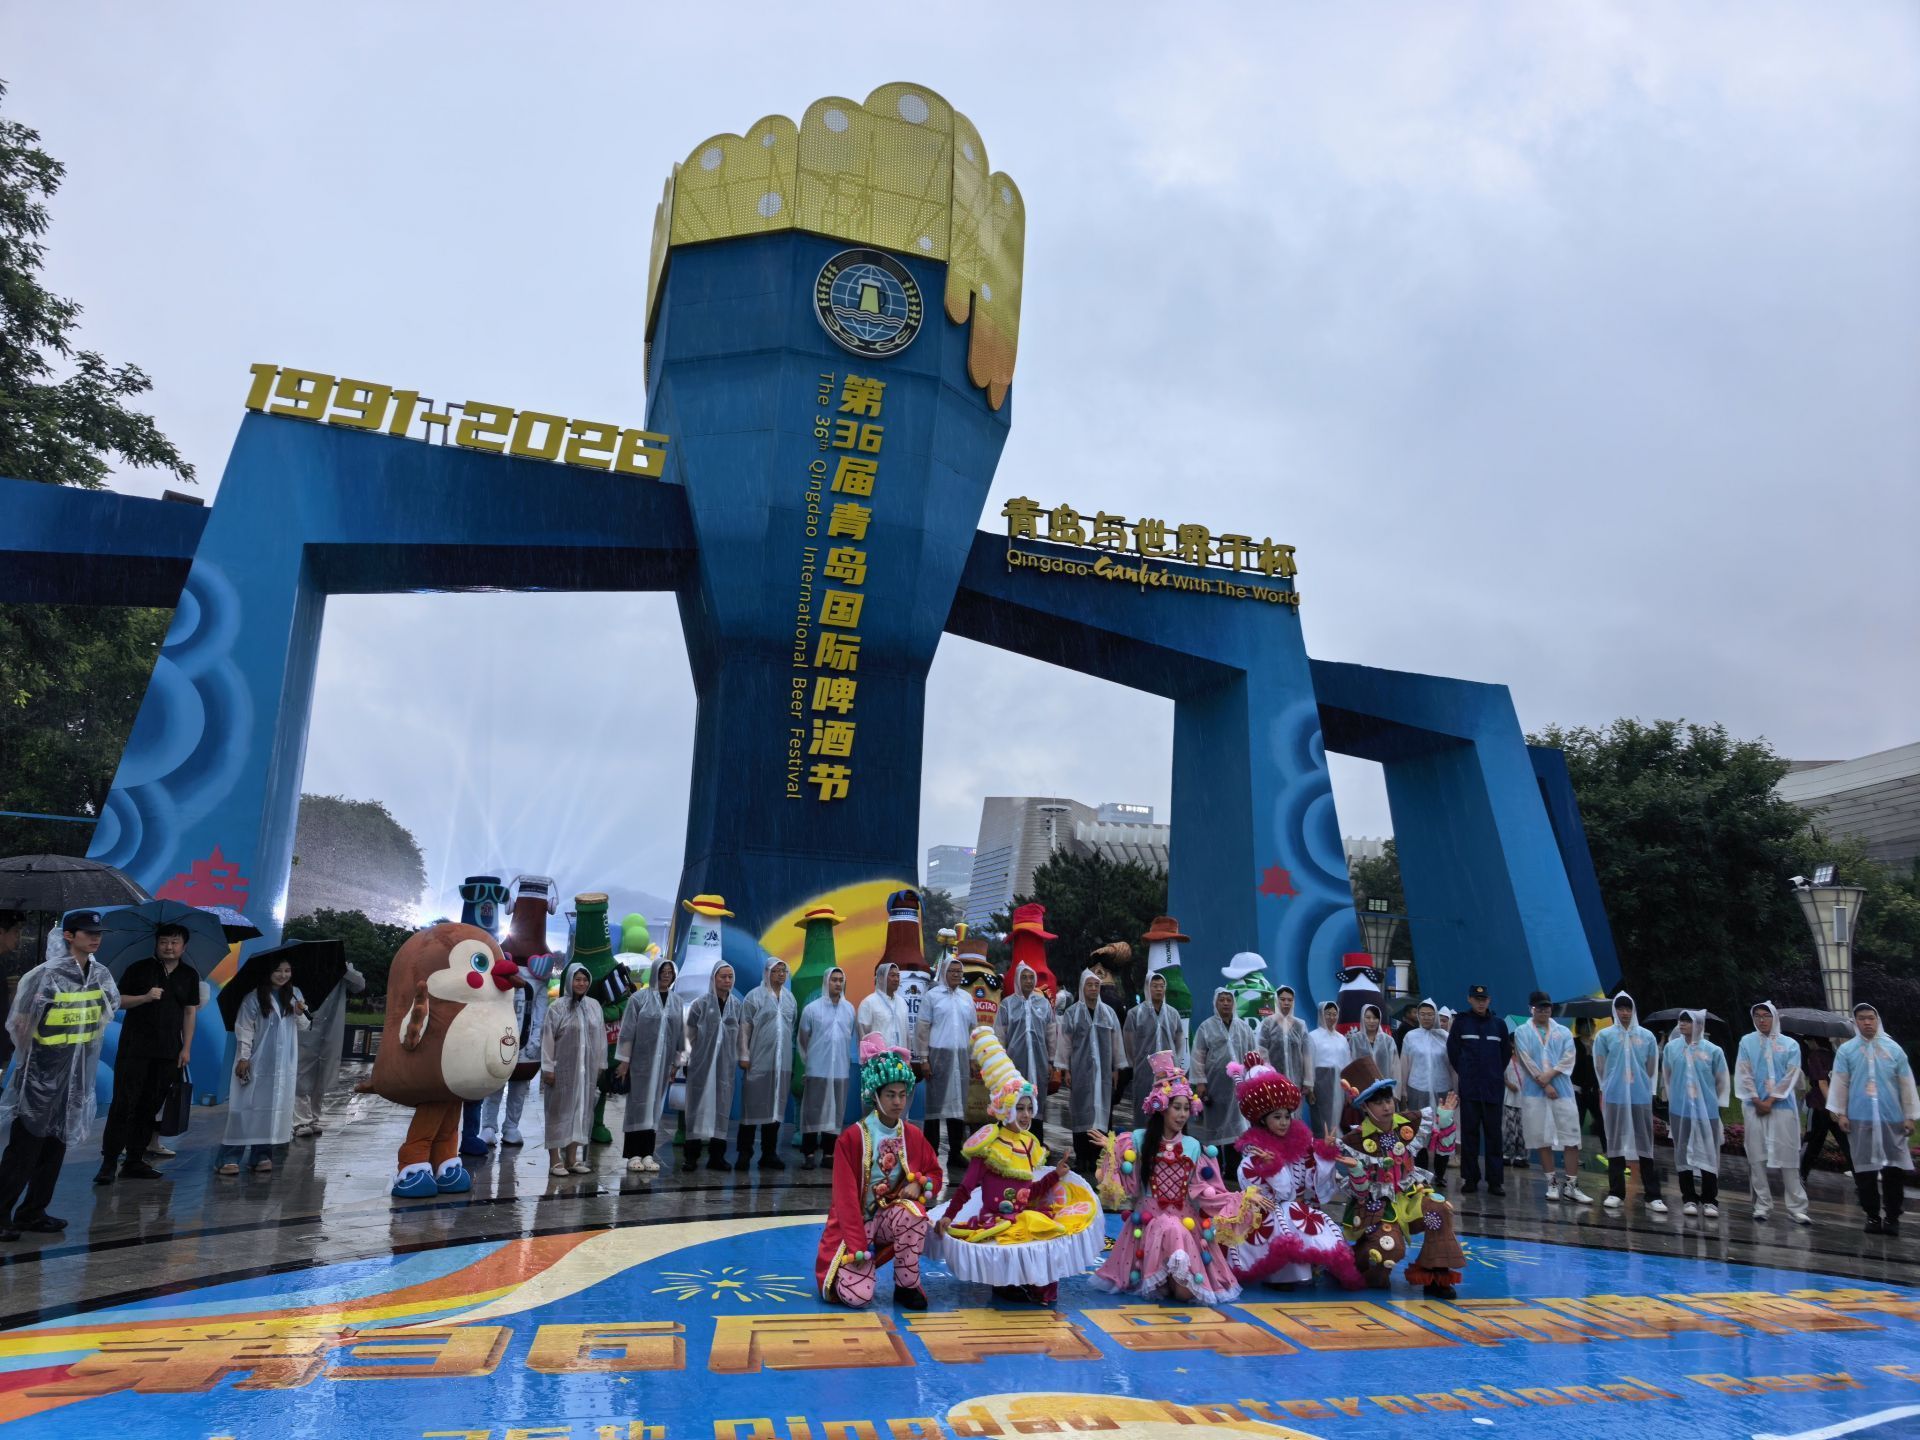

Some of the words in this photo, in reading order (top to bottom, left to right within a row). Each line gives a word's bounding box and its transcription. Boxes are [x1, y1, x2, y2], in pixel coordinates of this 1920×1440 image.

[817, 371, 835, 405] The
[245, 363, 670, 478] 1991-2026
[814, 415, 831, 451] 36th
[804, 459, 827, 537] Qingdao
[1001, 496, 1297, 577] 青岛与世界干杯
[792, 546, 818, 668] International
[807, 374, 886, 802] 第36届青岛国际啤酒节
[1172, 573, 1211, 594] With
[1216, 579, 1247, 599] The
[1252, 584, 1301, 606] World
[791, 677, 807, 719] Beer
[786, 728, 805, 799] Festival
[976, 1001, 997, 1012] NGTAO
[1152, 1375, 1682, 1426] International
[1684, 1372, 1868, 1396] Beer
